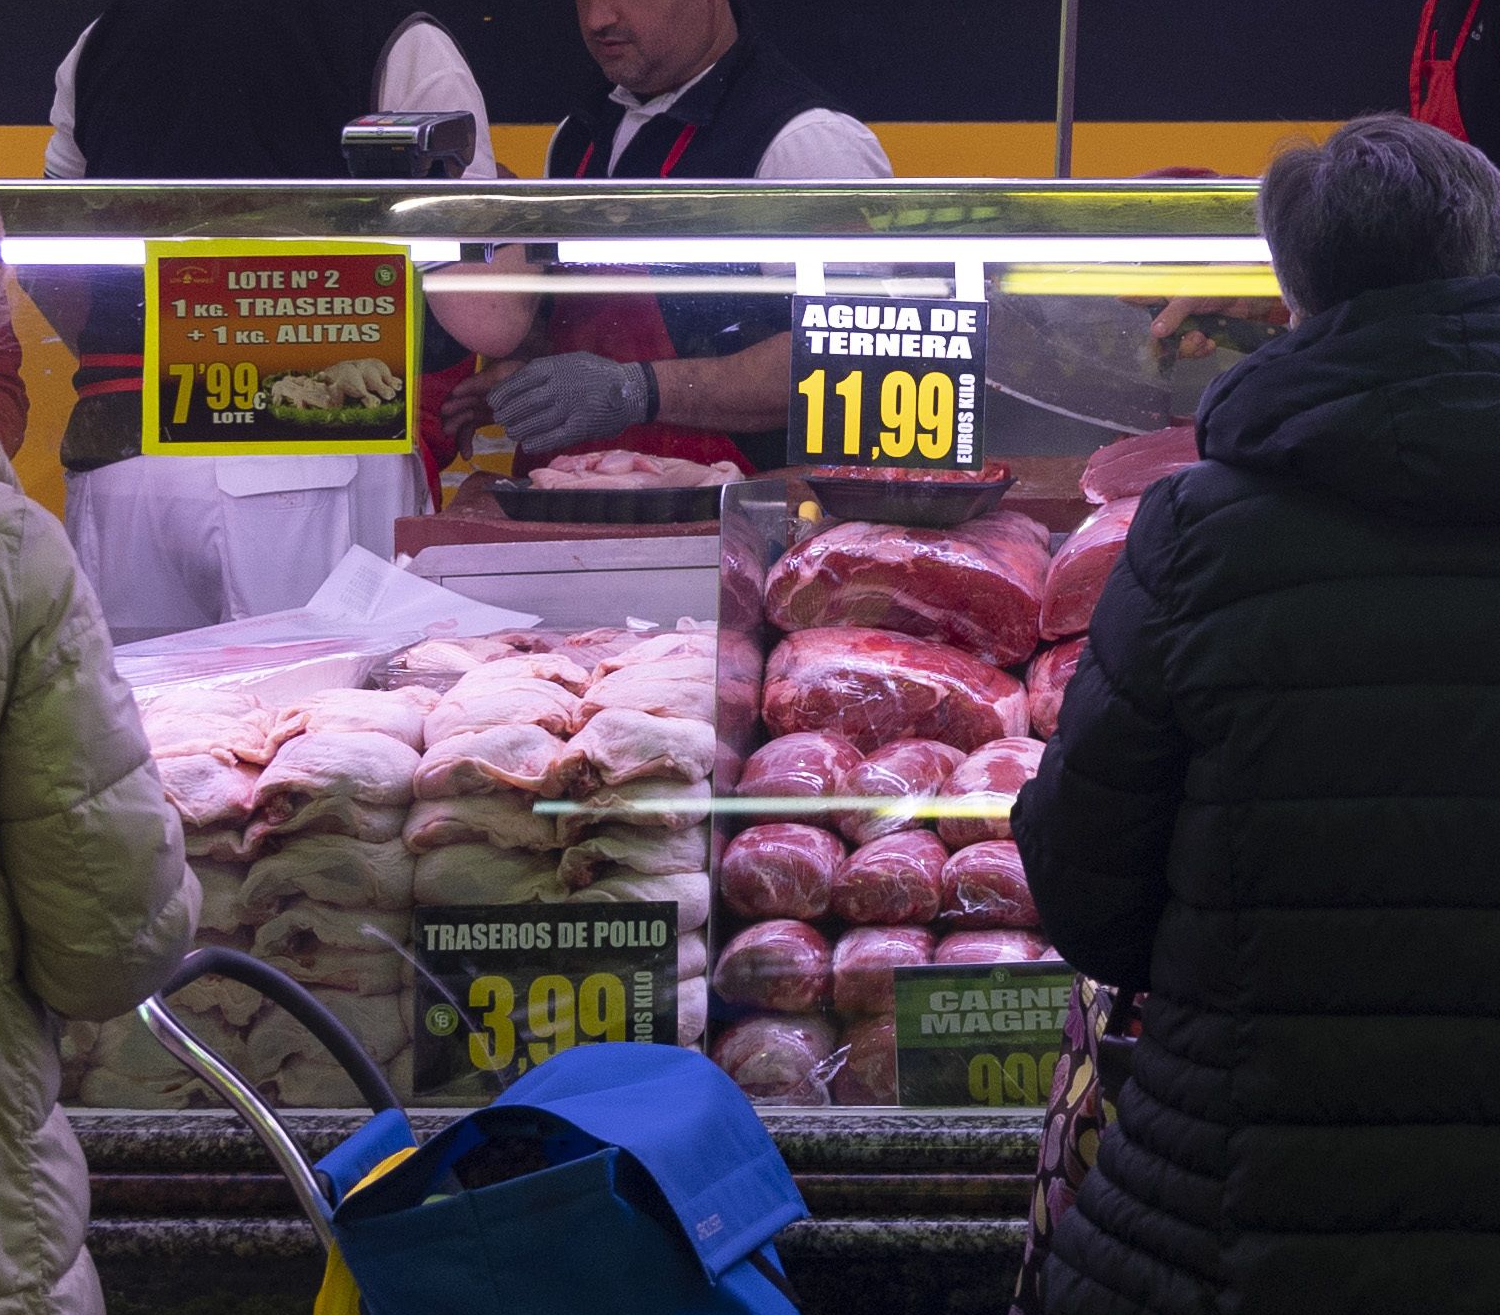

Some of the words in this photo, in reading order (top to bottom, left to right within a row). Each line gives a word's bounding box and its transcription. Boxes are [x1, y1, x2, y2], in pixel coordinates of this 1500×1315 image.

[227, 270, 284, 290] LOTE
[324, 269, 340, 288] 2
[171, 299, 186, 318] 1
[194, 304, 228, 318] KG.
[236, 296, 395, 317] TRASEROS
[801, 304, 922, 331] AGUJA
[930, 308, 977, 333] DE
[187, 329, 205, 341] +
[212, 326, 228, 344] 1
[235, 331, 270, 344] KG.
[276, 323, 381, 343] ALITAS
[806, 331, 973, 359] TERNERA
[213, 412, 254, 424] LOTE
[798, 369, 954, 460] 11,99
